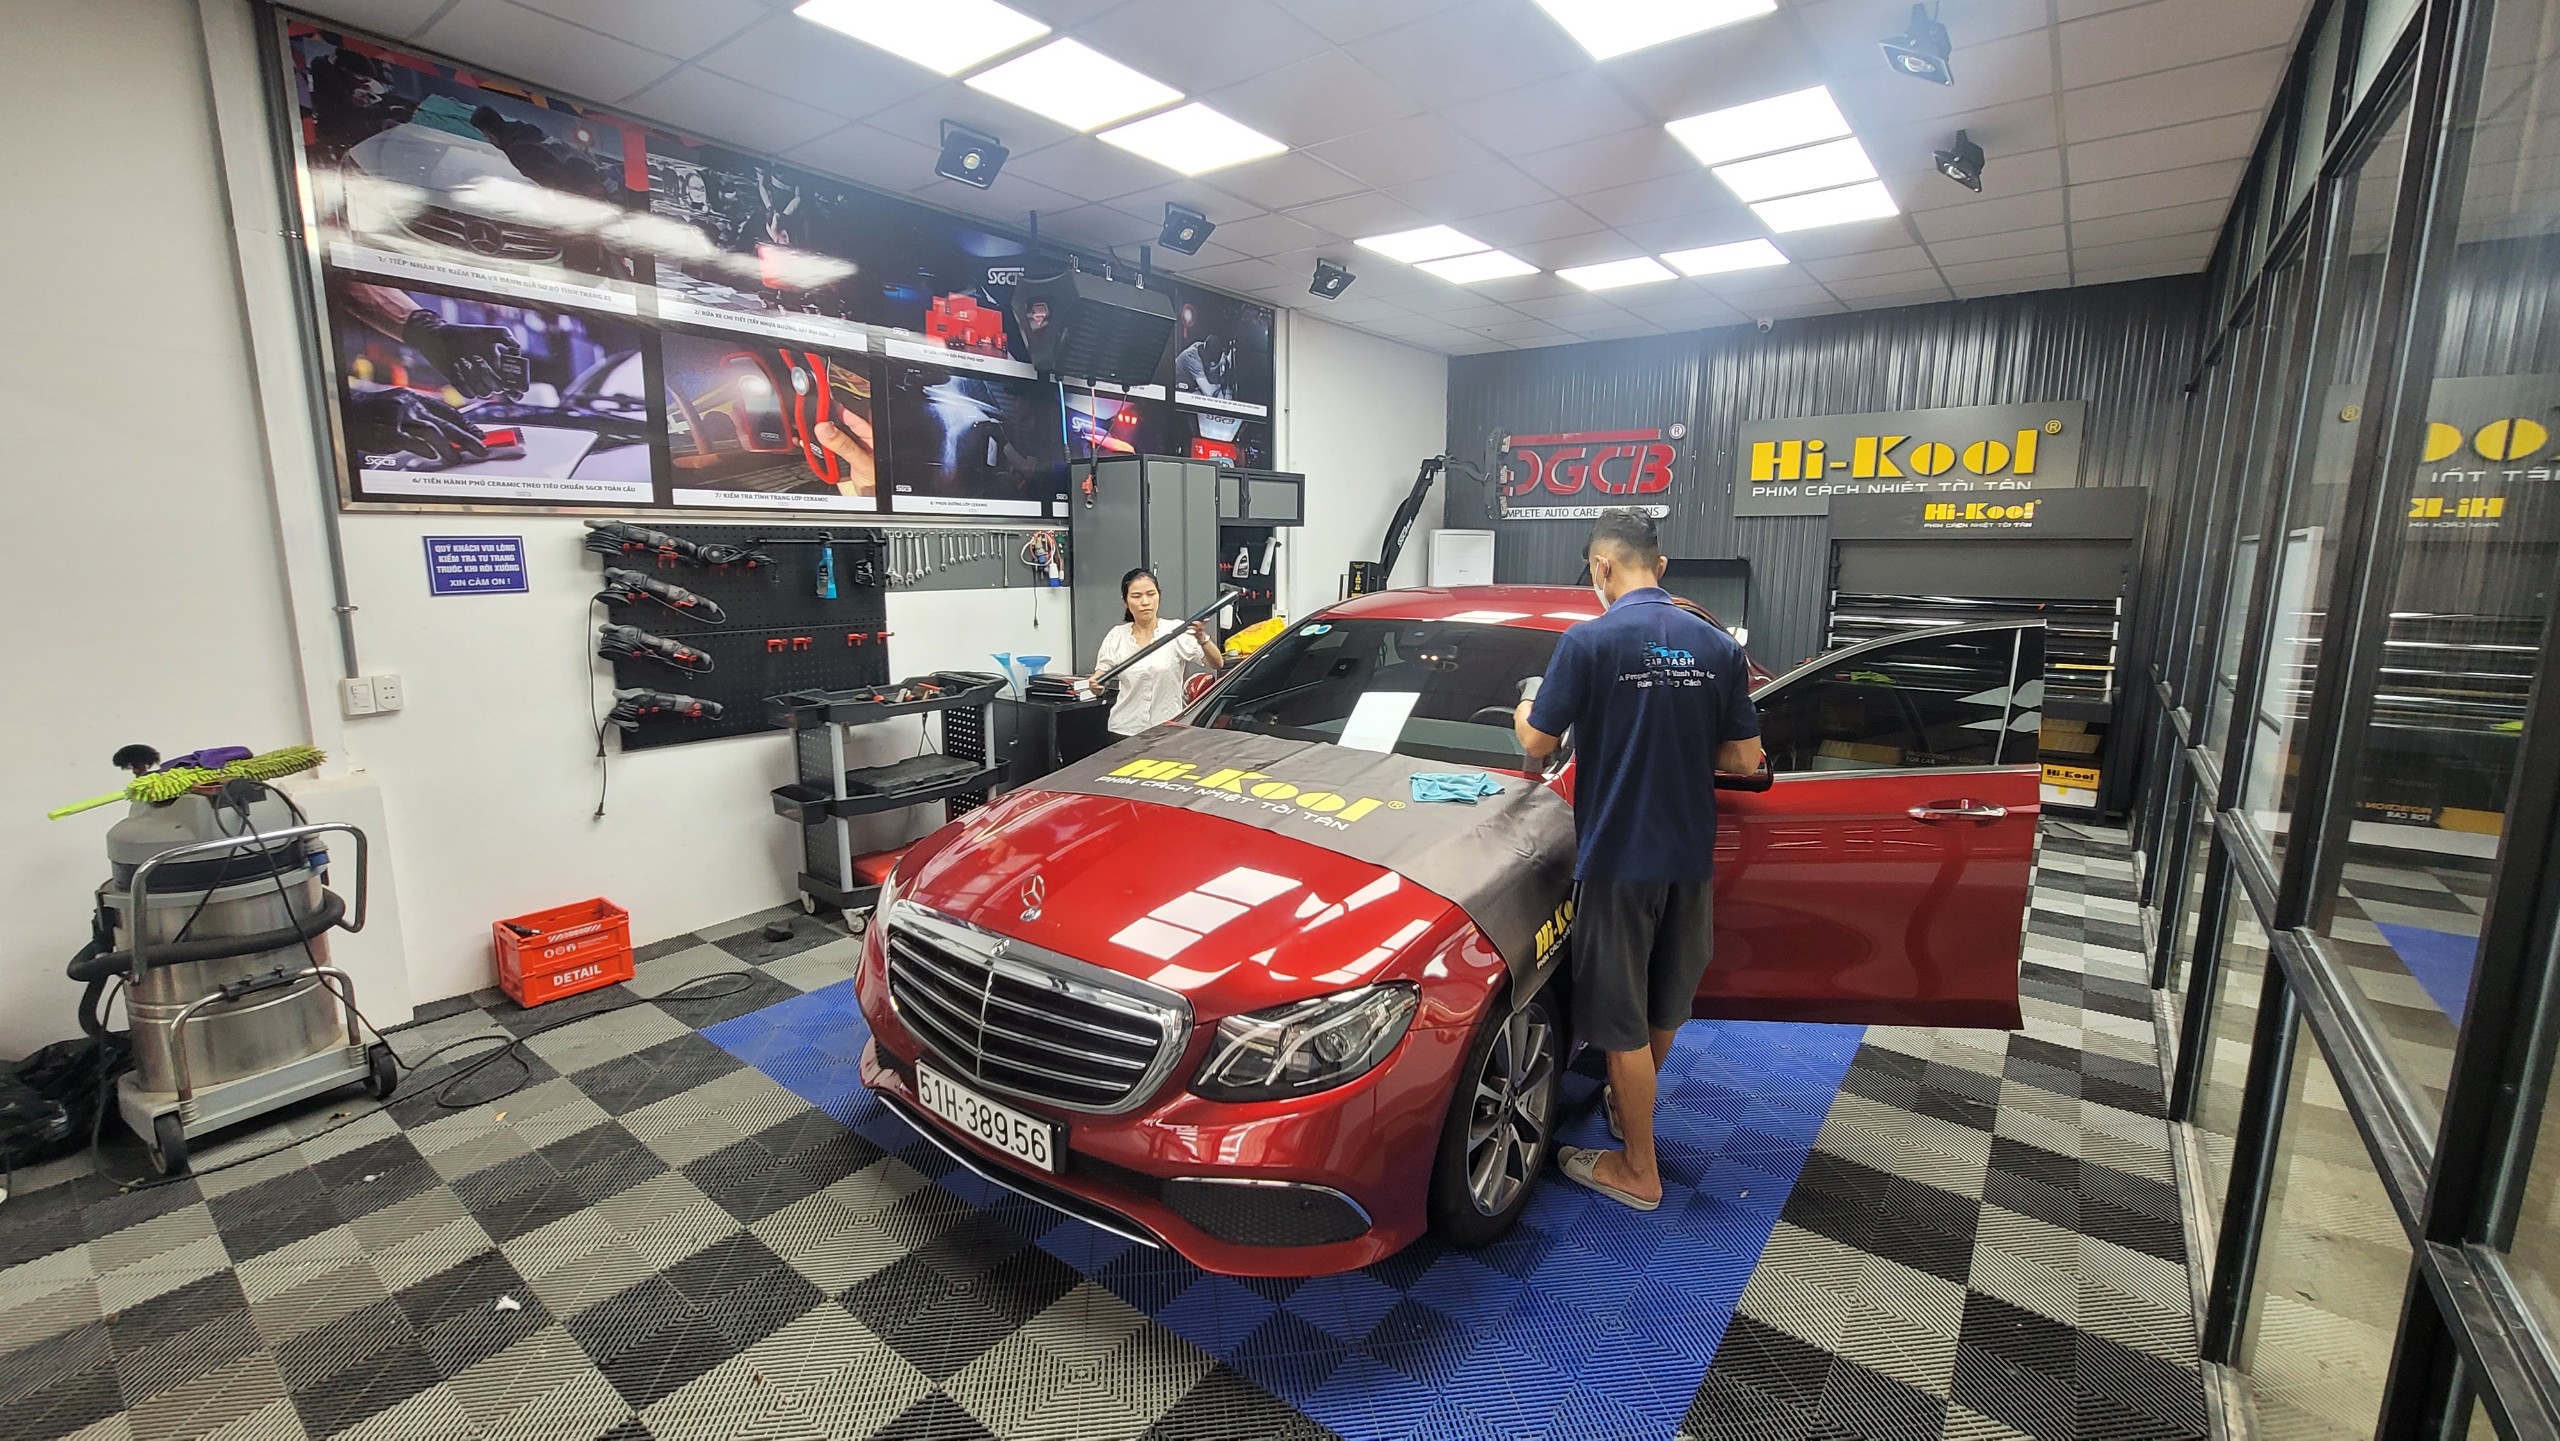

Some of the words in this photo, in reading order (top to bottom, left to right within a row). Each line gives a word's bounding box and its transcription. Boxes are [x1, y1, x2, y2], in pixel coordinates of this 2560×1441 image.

[437, 265, 447, 273] XE
[471, 271, 486, 280] TRA
[365, 455, 397, 466] SGCB
[1750, 430, 2038, 481] Hi-Kool
[423, 476, 442, 485] TIẾN
[443, 477, 467, 486] HÀNH
[487, 480, 521, 488] CERAMIC
[1752, 486, 1798, 497] PHIM
[1805, 482, 1860, 496] CÁCH
[1507, 508, 1540, 518] MPLETE
[1545, 508, 1569, 517] AUTO
[1573, 508, 1598, 517] CARE
[1924, 502, 2035, 520] Hi-Kool
[434, 544, 451, 553] QUÝ
[453, 544, 480, 552] KHÁCH
[481, 544, 495, 552] VUI
[496, 543, 516, 552] LÒNG
[490, 554, 515, 562] TRANG
[450, 579, 466, 587] XIN
[2047, 769, 2094, 780] Hi-Kool
[1108, 759, 1384, 822] Hi-Kool
[1094, 775, 1140, 785] PHIM
[1140, 779, 1191, 793] CÁCH
[1193, 786, 1256, 805] NHIỆT
[1302, 812, 1350, 831] TÂN
[1535, 900, 1573, 960] Hi-Ko
[553, 964, 602, 987] DETAIL
[920, 1070, 1046, 1163] 51H-389.56
